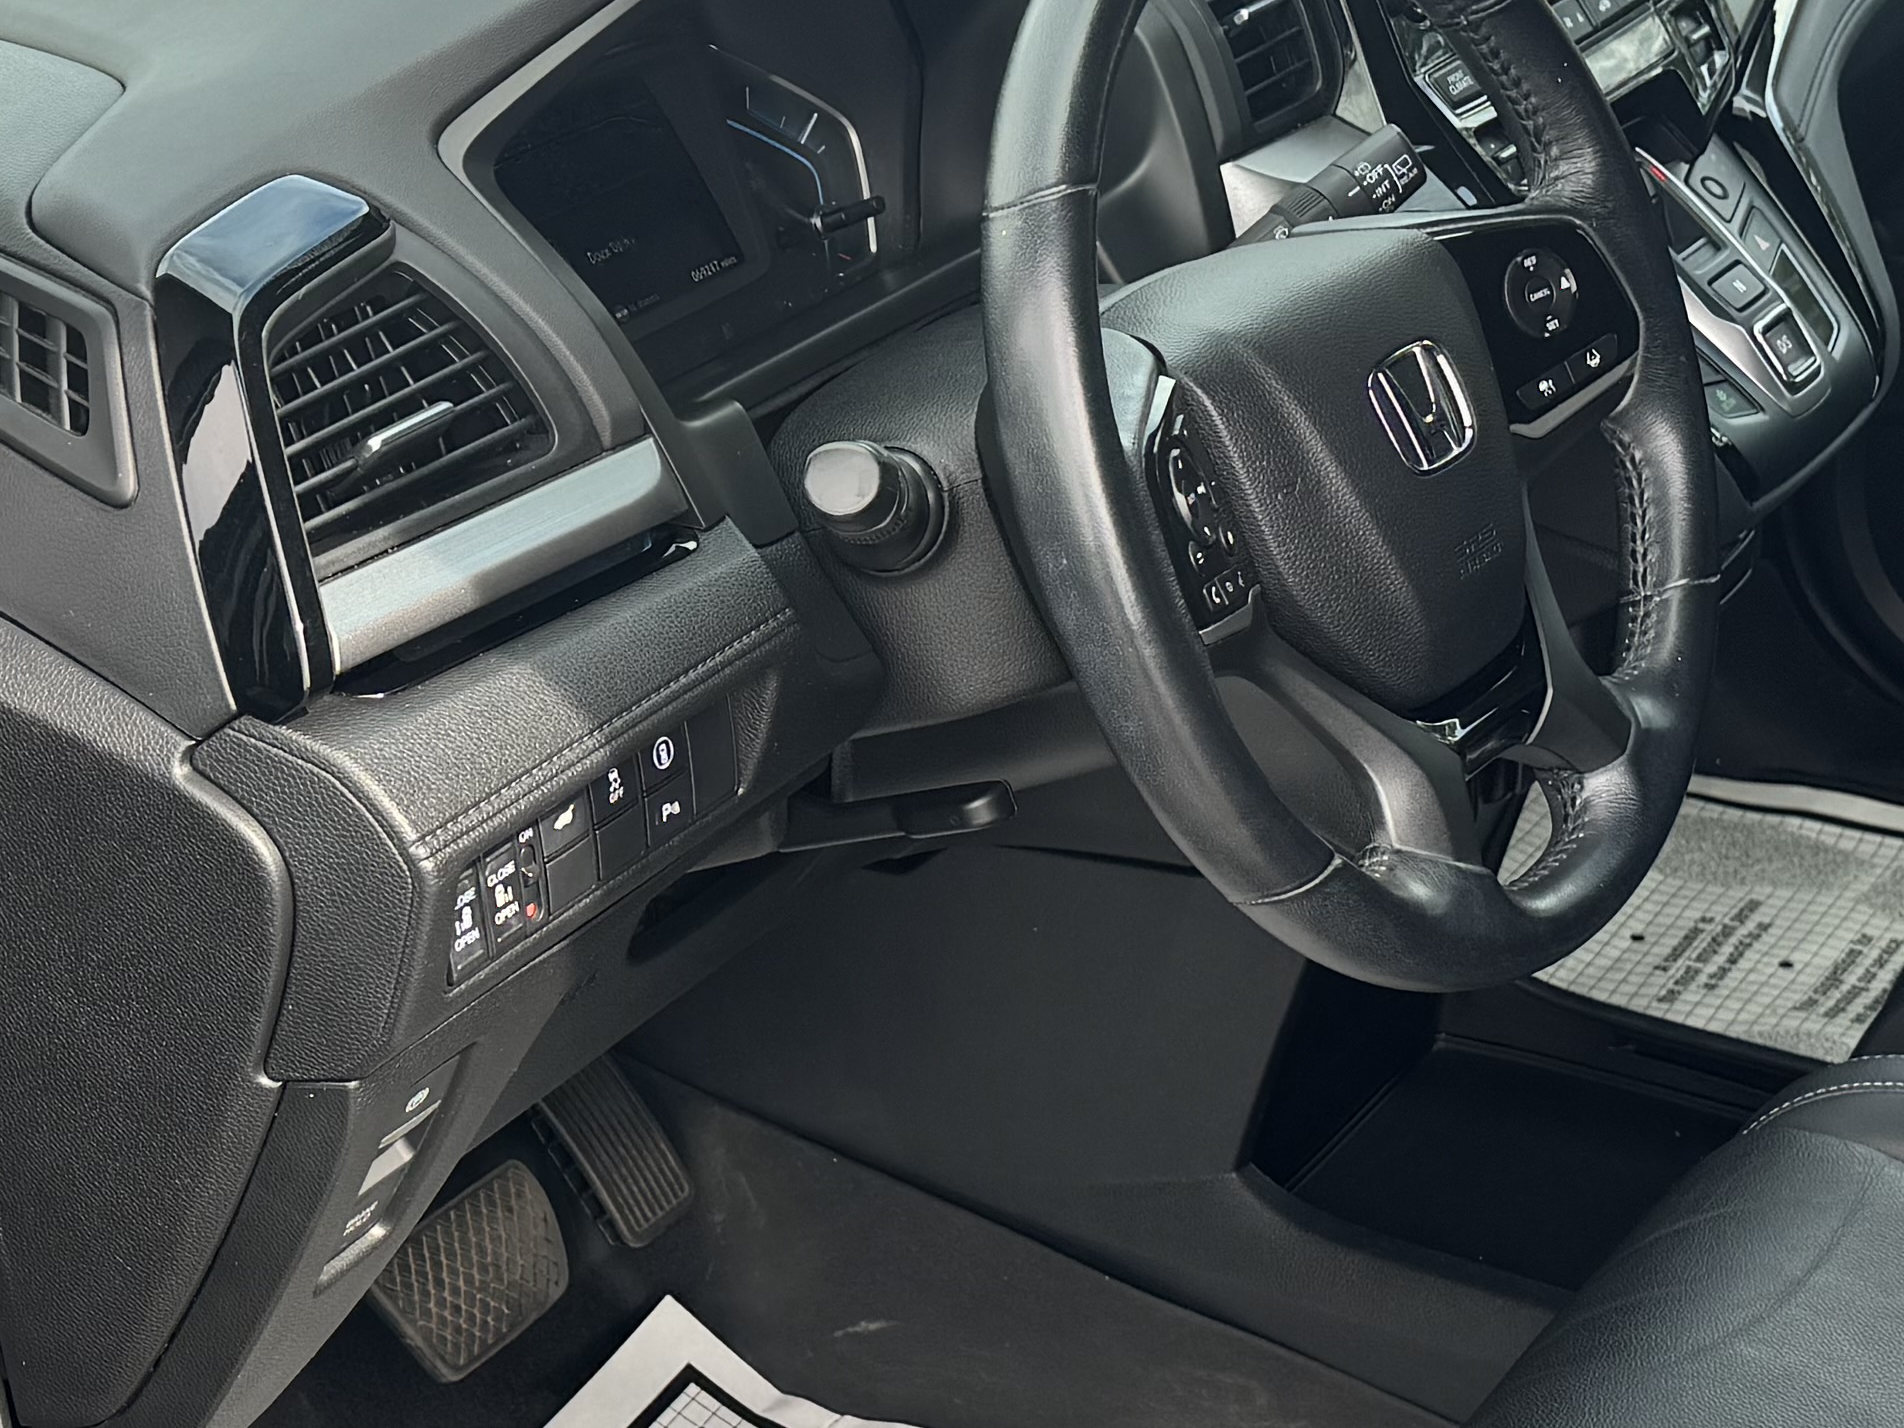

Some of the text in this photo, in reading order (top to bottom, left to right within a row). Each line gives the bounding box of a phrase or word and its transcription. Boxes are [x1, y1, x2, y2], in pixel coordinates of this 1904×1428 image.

[518, 827, 534, 843] ON
[487, 860, 516, 888] CLOSE
[494, 900, 520, 926] OPEN
[454, 926, 481, 952] OPEN
